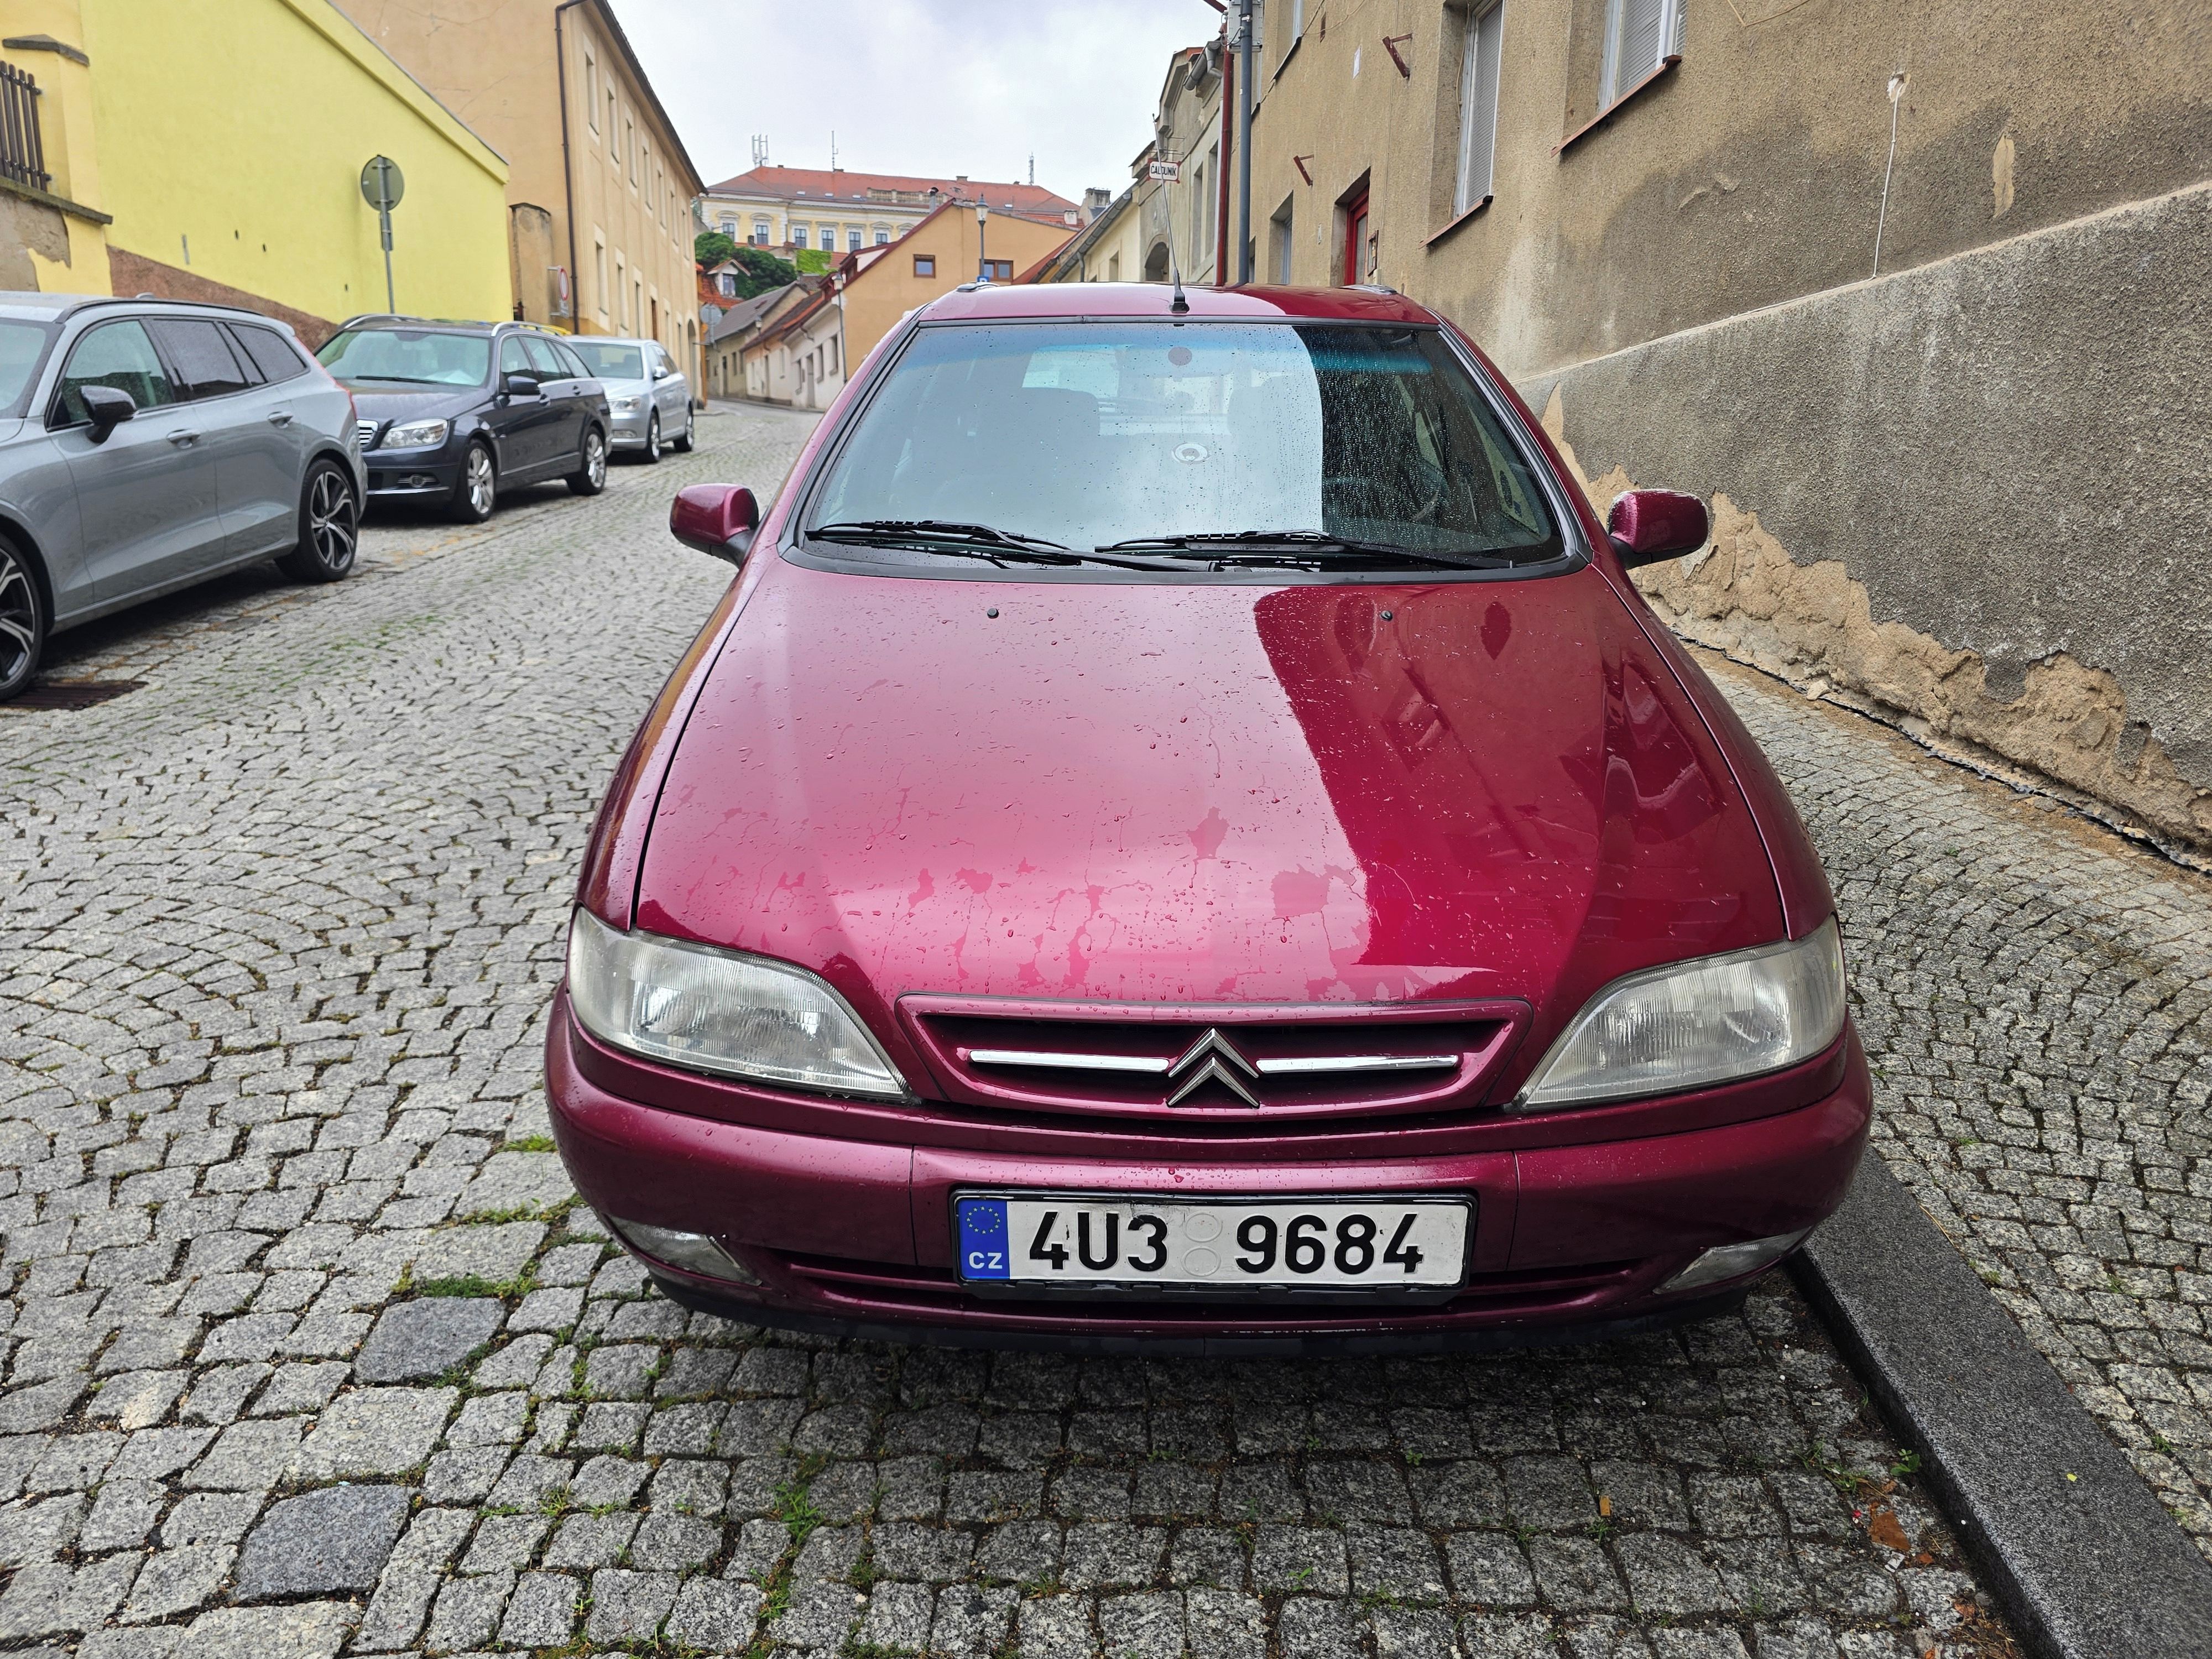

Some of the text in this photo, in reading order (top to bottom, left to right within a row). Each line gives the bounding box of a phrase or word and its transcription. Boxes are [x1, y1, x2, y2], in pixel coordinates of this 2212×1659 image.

[968, 1251, 1003, 1269] CZ
[1029, 1211, 1423, 1275] 4U3 9684
